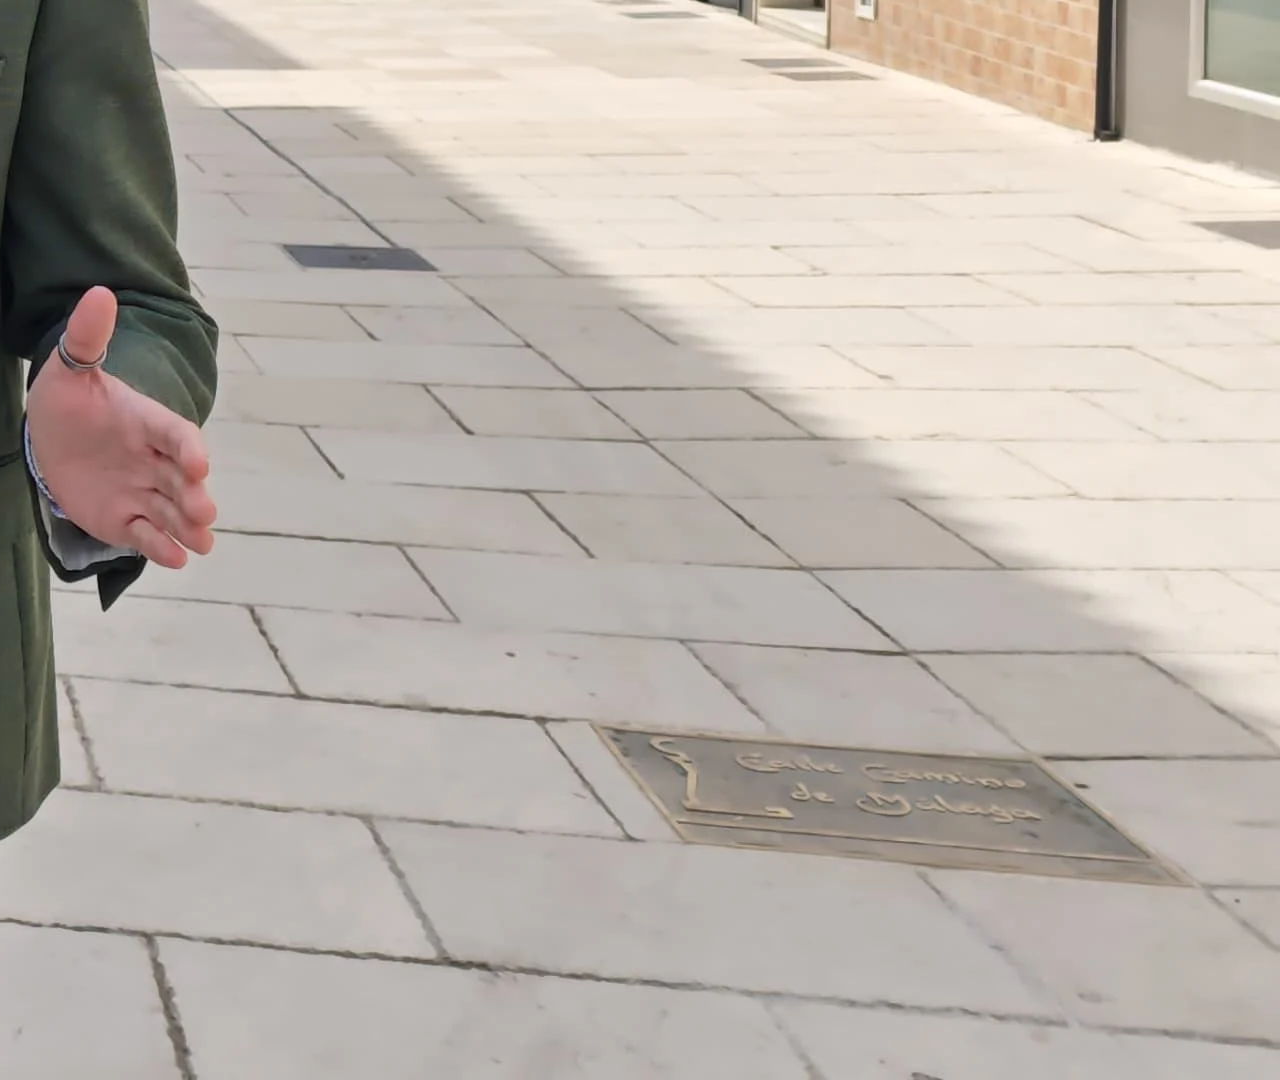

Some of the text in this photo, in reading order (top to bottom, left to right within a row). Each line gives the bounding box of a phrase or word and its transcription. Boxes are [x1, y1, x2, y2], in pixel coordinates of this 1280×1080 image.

[736, 752, 1027, 789] Calle Camino
[791, 782, 835, 804] de
